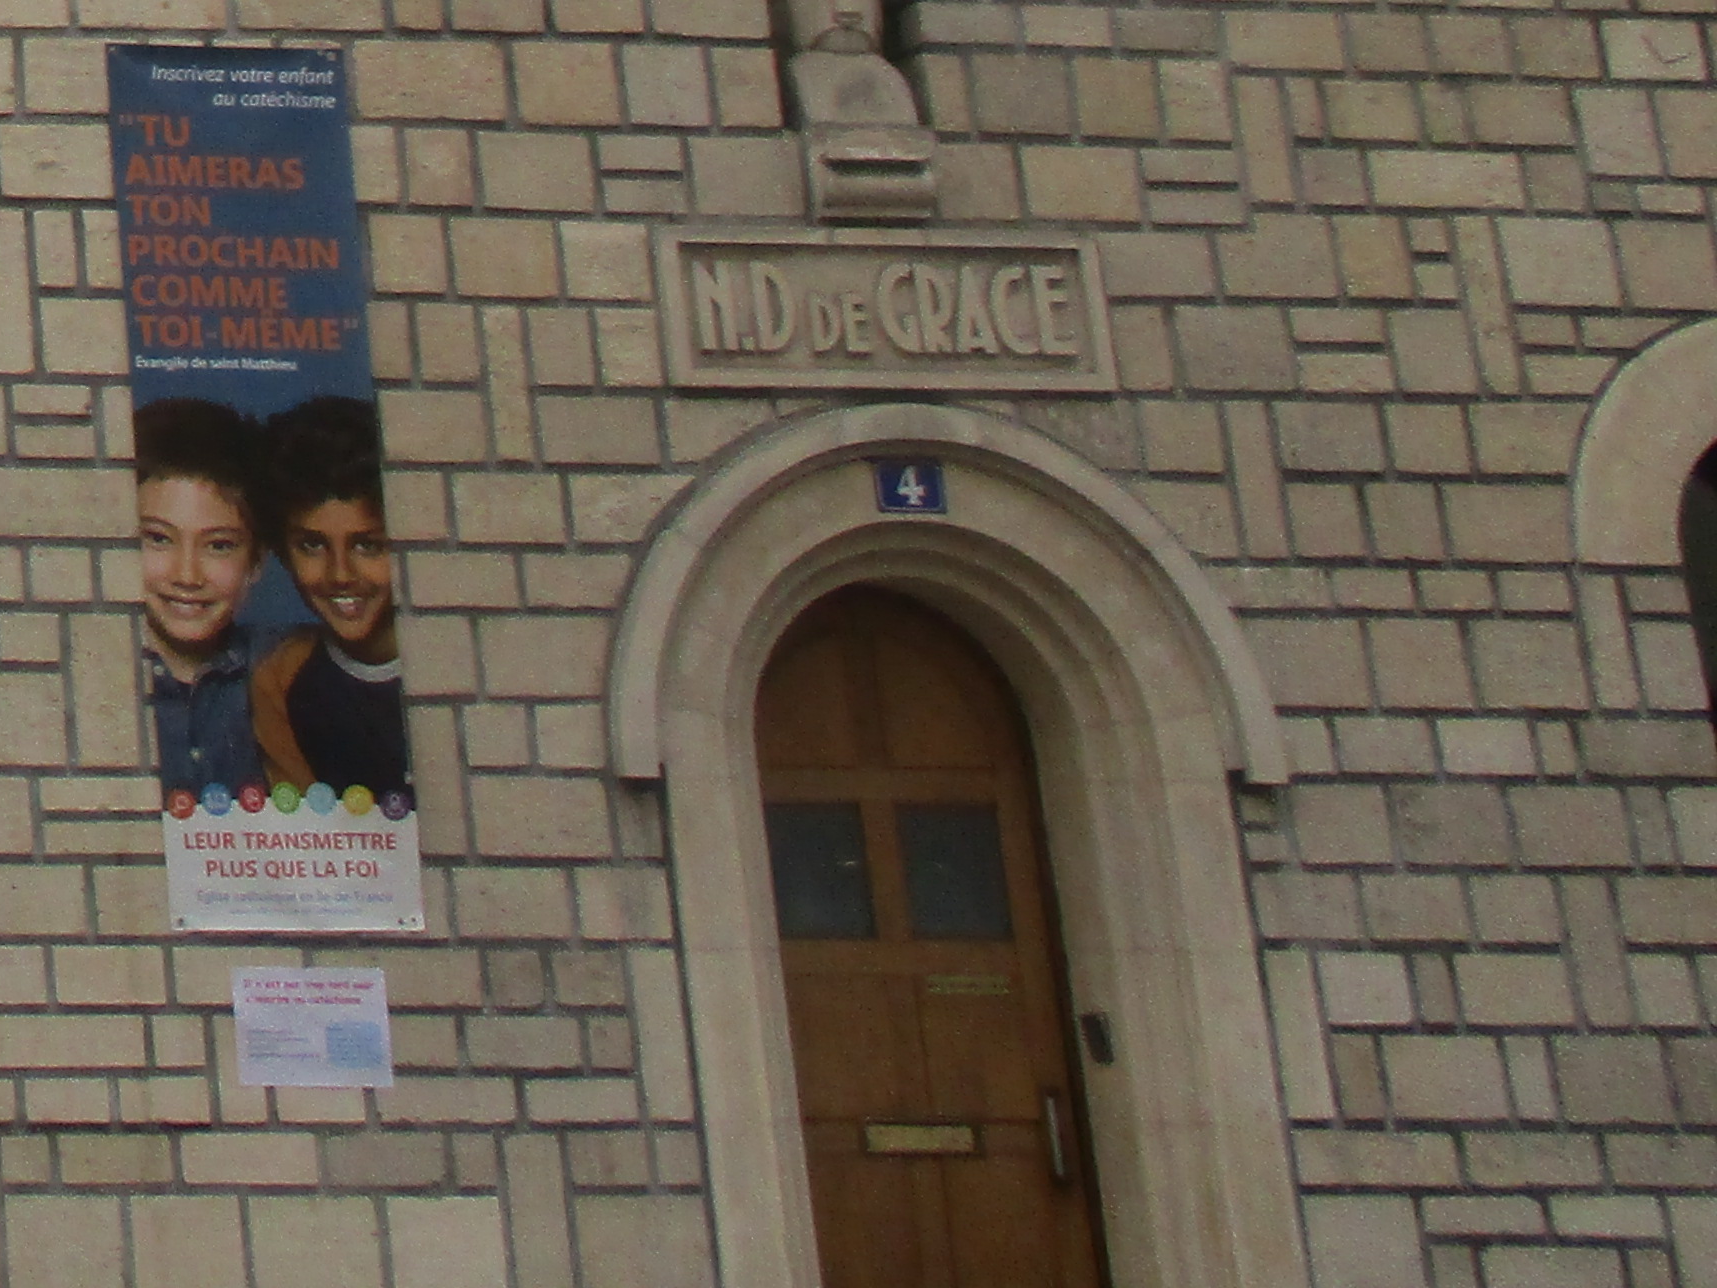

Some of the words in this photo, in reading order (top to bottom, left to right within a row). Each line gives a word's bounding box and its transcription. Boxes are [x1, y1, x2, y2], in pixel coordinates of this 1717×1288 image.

[152, 66, 225, 84] Inscrivez
[230, 69, 274, 85] votre
[279, 68, 335, 87] enfant
[213, 94, 236, 107] au
[241, 91, 337, 110] catéchisme
[125, 154, 304, 190] AIMERAS
[127, 195, 212, 227] TON
[128, 234, 339, 270] PROCHAIN
[131, 274, 289, 309] COMME
[810, 292, 871, 354] DE
[877, 263, 1080, 356] GRACE
[191, 356, 207, 369] de
[895, 465, 925, 506] 4
[183, 832, 236, 850] LEUR
[242, 832, 397, 851] TRANSMETTRE
[205, 860, 257, 879] PLUS
[264, 861, 306, 880] QUE
[312, 861, 337, 879] LA
[345, 861, 379, 878] FOI
